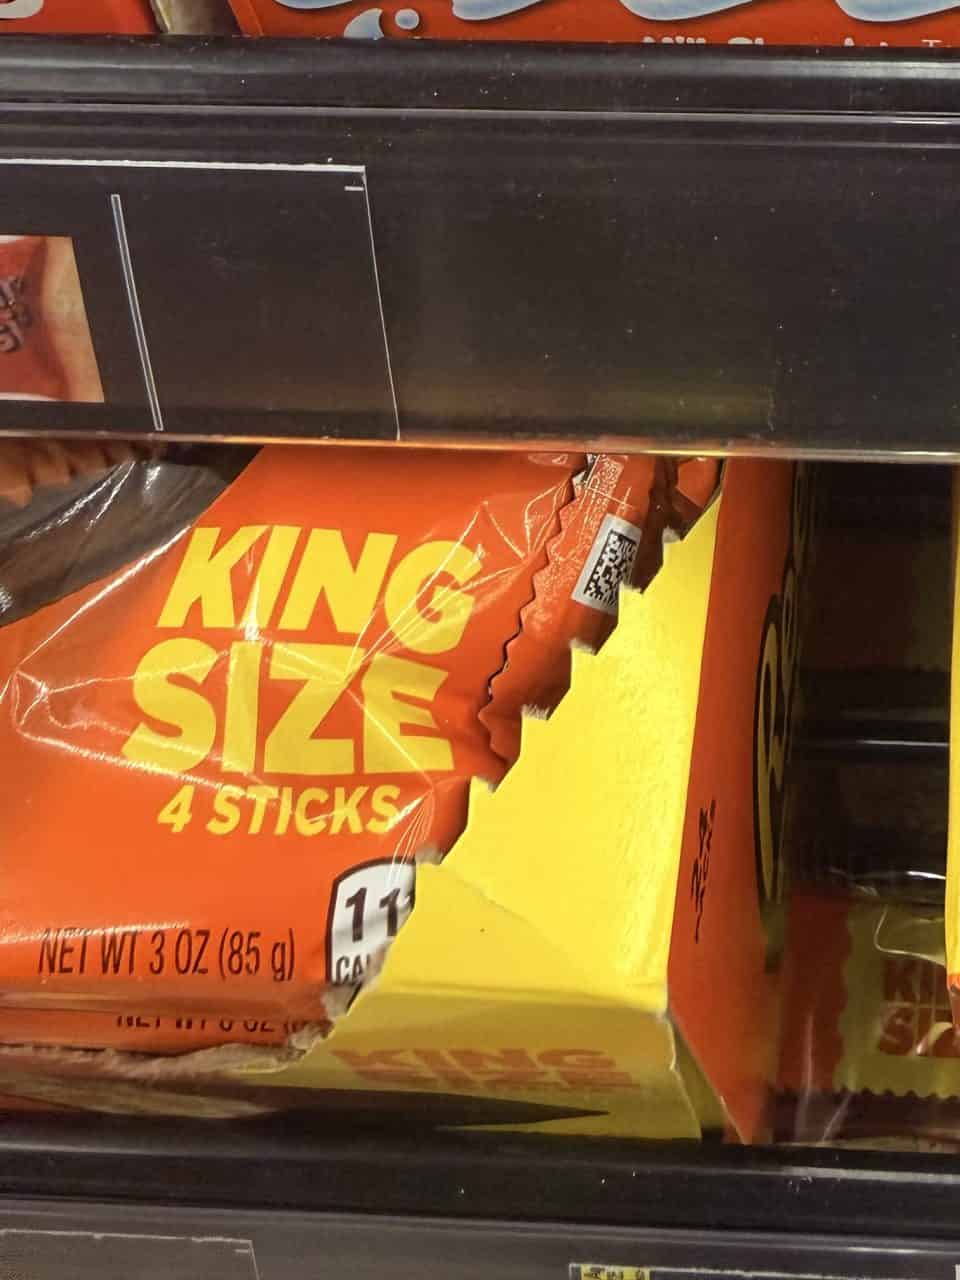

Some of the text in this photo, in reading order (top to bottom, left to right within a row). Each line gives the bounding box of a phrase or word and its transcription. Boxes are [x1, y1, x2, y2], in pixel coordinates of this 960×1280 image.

[157, 524, 484, 657] KING
[119, 638, 455, 777] SIZE
[157, 784, 403, 837] 4 STICKS
[38, 929, 89, 975] NET
[101, 930, 138, 974] WT
[149, 930, 165, 975] 3
[175, 929, 210, 975] OZ
[219, 927, 261, 980] (85
[271, 927, 295, 982] g)
